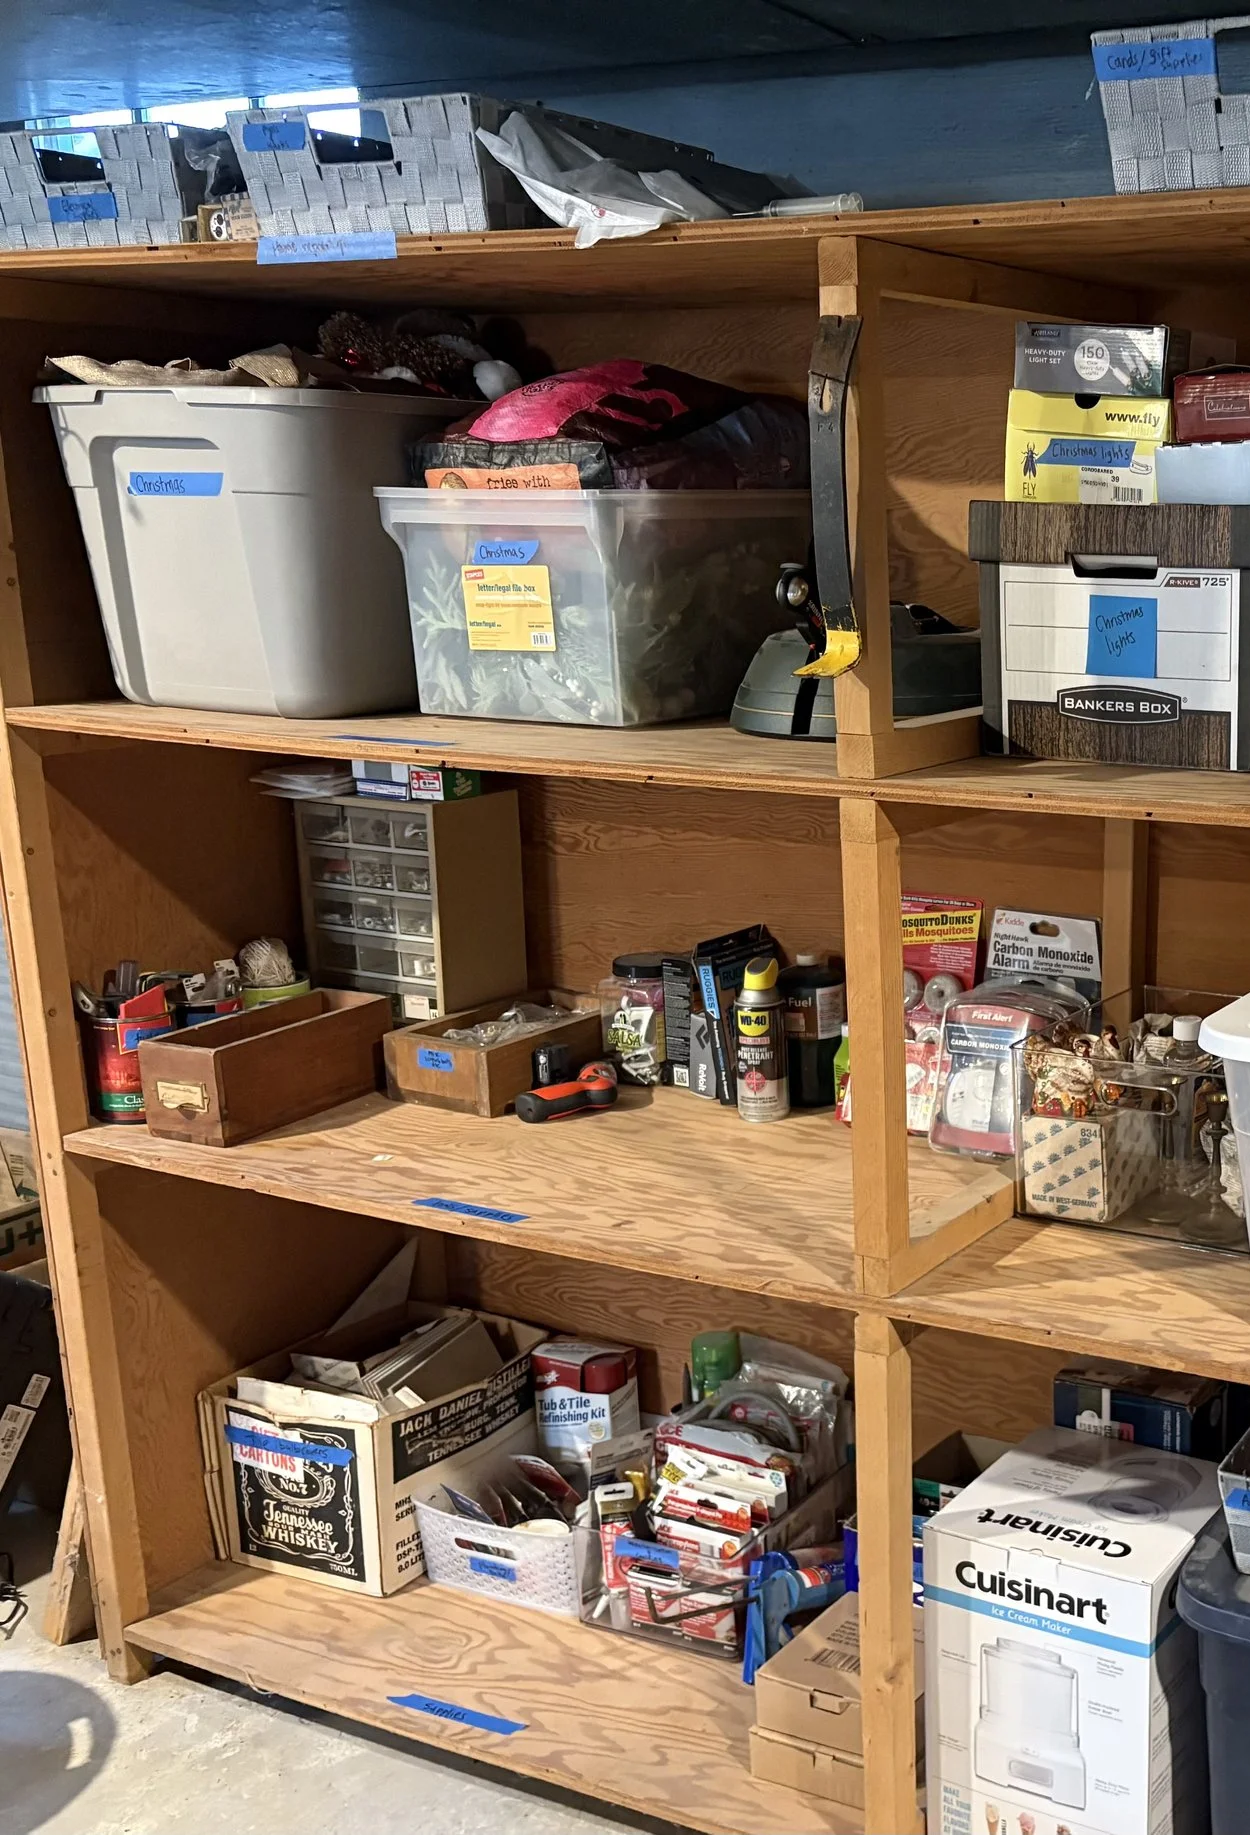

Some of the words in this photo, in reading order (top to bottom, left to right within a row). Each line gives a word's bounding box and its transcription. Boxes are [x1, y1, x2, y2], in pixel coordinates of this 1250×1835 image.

[1025, 348, 1066, 357] HEAVY-DUTY
[1080, 346, 1105, 360] 150
[1052, 442, 1097, 458] Christmas
[1101, 448, 1130, 463] lights
[136, 474, 185, 493] Christmas
[523, 474, 551, 489] with
[1111, 475, 1120, 483] 39
[1022, 482, 1036, 496] FLY
[479, 545, 525, 559] Christmas
[477, 584, 511, 592] letter/legal
[523, 584, 535, 592] box
[1095, 606, 1144, 632] Christmas
[1104, 631, 1136, 657] lights
[1064, 697, 1135, 713] BANKERS
[1139, 702, 1172, 715] BOX
[902, 917, 940, 928] OSQUITO
[1004, 918, 1024, 926] Kidde
[916, 926, 974, 937] Mosquitoes
[993, 941, 1033, 957] Carbon
[1038, 946, 1094, 964] Monoxide
[993, 953, 1029, 969] Alarm
[702, 968, 715, 1008] RUGGIES
[788, 997, 812, 1007] Fuel
[740, 1015, 766, 1025] WD-40
[972, 1010, 991, 1019] First
[992, 1012, 1013, 1023] Alert
[607, 1028, 641, 1046] SALSA
[951, 1039, 977, 1047] CARBON
[979, 1041, 1009, 1051] MONOXI
[738, 1050, 773, 1060] PENETRANT
[698, 1063, 707, 1092] ReVolt
[1080, 1128, 1098, 1138] 834
[399, 1413, 433, 1437] JACK
[440, 1391, 483, 1418] DANIEL
[486, 1358, 531, 1397] DISTILLE
[539, 1398, 556, 1411] Tub
[567, 1397, 590, 1409] Tile
[539, 1410, 588, 1423] Refinishing
[591, 1407, 605, 1419] Kit
[657, 1424, 683, 1436] ACE
[240, 1443, 297, 1473] CARTONS
[263, 1499, 333, 1535] Tennessee
[283, 1505, 309, 1515] QUALITY
[657, 1525, 672, 1533] ACE
[977, 1508, 1132, 1558] Cuisinart
[262, 1524, 338, 1554] WHISKEY
[955, 1560, 1107, 1625] Cuisinart
[991, 1605, 1004, 1617] Ice
[1007, 1609, 1038, 1626] Cream
[1042, 1618, 1072, 1635] Maker
[424, 1703, 466, 1721] Supplies
